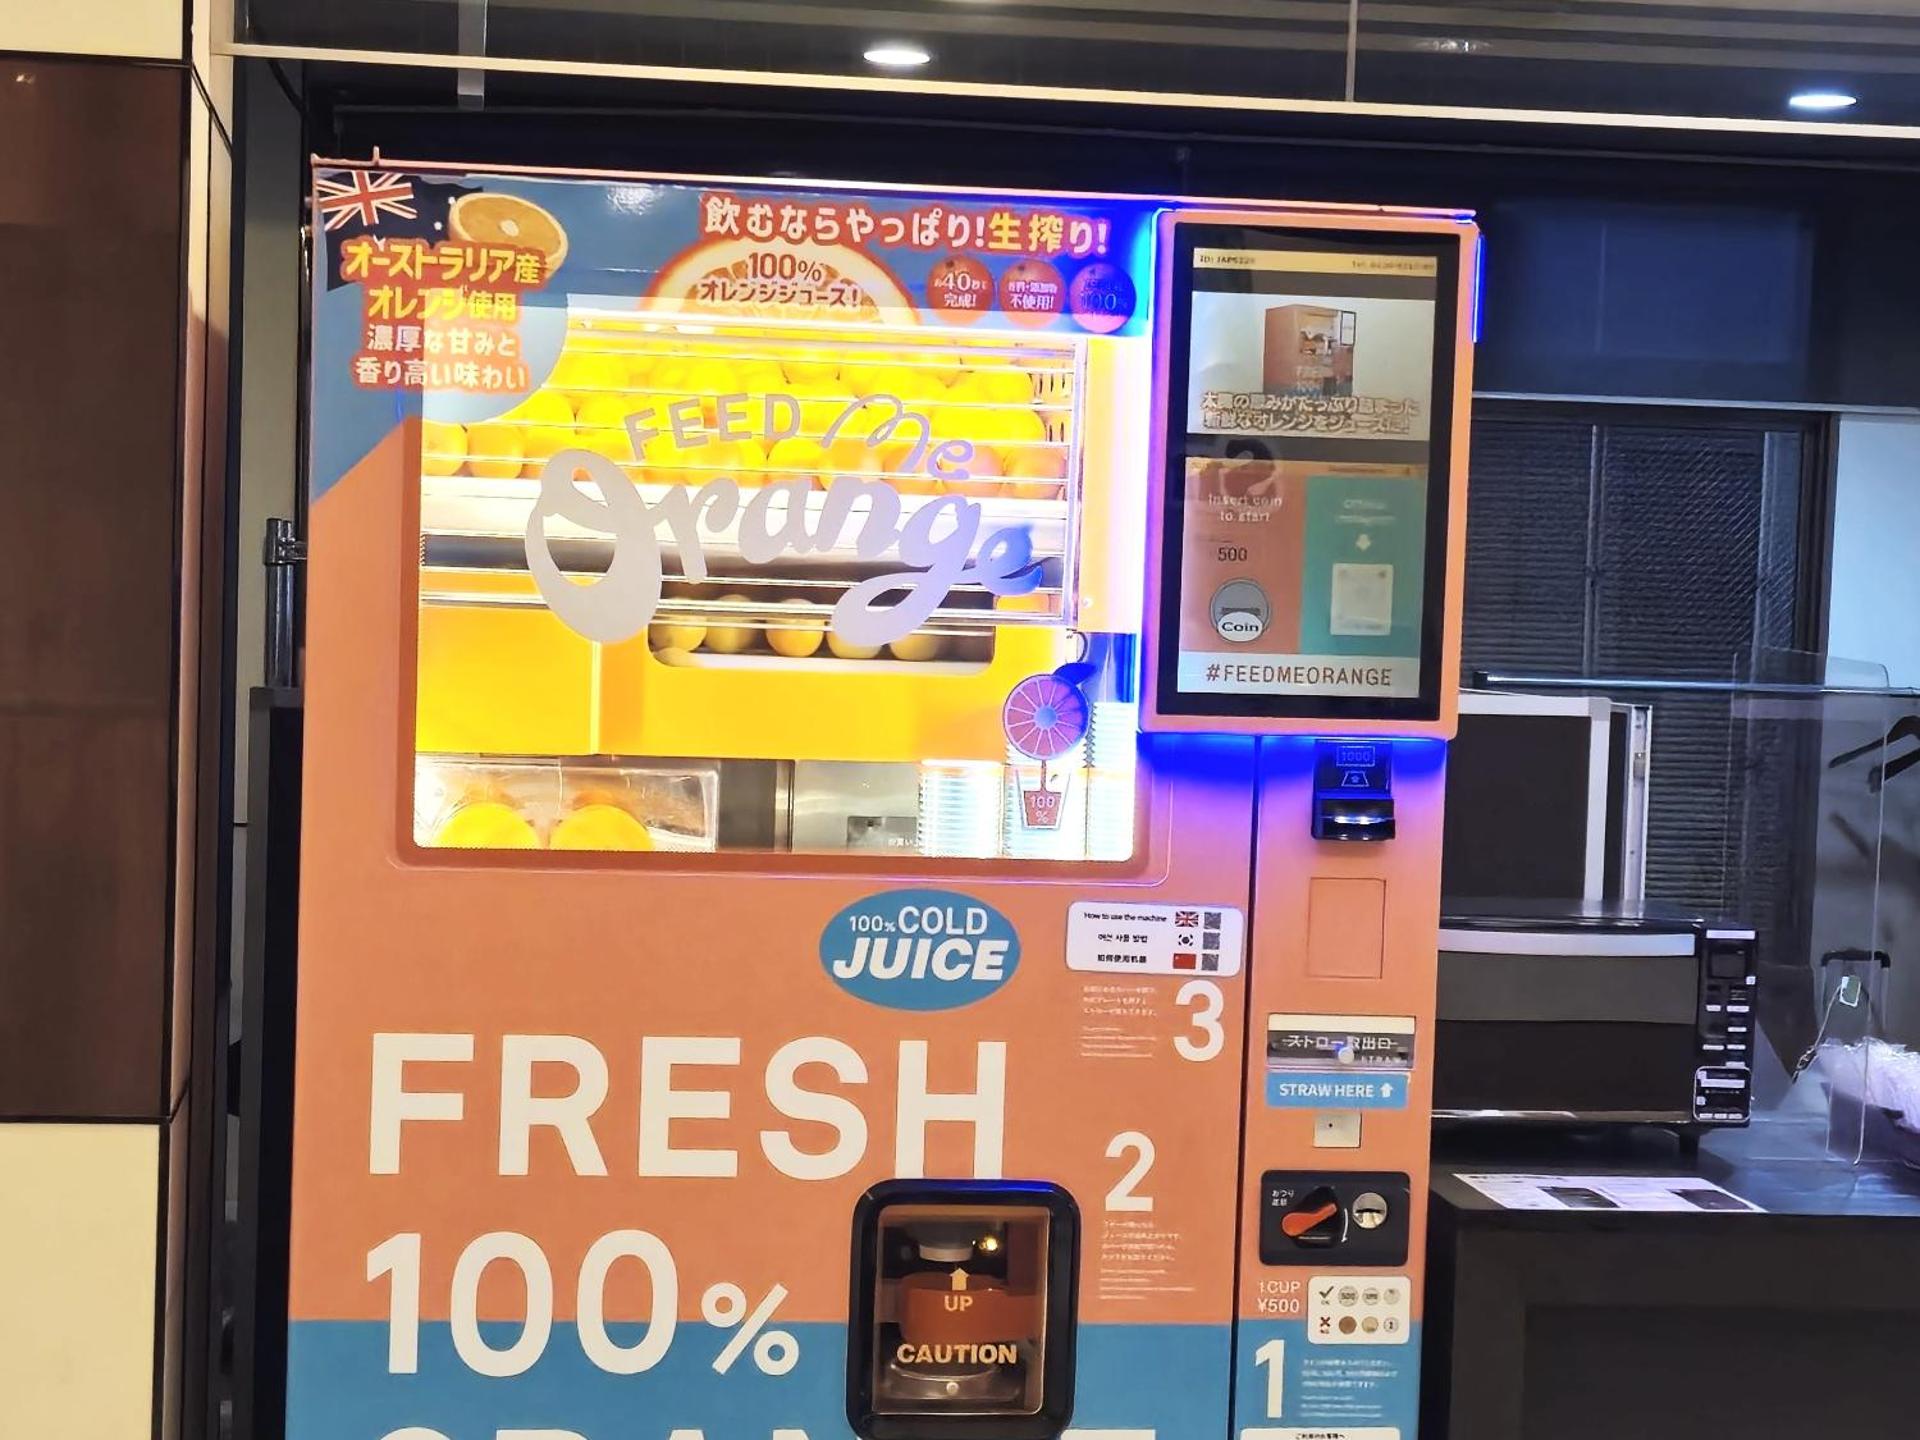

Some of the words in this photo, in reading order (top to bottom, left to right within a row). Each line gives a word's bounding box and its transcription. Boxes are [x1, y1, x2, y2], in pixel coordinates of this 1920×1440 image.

[346, 243, 541, 284] オーストラリア産
[749, 252, 822, 283] 100%
[368, 286, 517, 322] オレンジ使用
[700, 281, 859, 308] オレンジジュース!
[367, 323, 517, 359] 濃厚な甘みと
[355, 355, 525, 390] 香り高い味わい
[624, 393, 800, 462] FEED
[1220, 510, 1234, 522] to
[525, 448, 1044, 644] Orange
[1217, 546, 1248, 562] 500
[1221, 621, 1259, 632] Coin
[1206, 663, 1393, 687] #FEEDMEORANGE
[1030, 795, 1055, 808] 100
[849, 915, 896, 933] 100%
[899, 906, 988, 936] COLD
[1083, 911, 1101, 920] How
[1102, 912, 1110, 920] to
[1111, 913, 1123, 921] use
[1124, 913, 1136, 921] the
[1137, 914, 1167, 923] machine
[832, 937, 1010, 981] JUICE
[1173, 979, 1225, 1062] 3
[1279, 1083, 1331, 1097] STRAW
[1335, 1084, 1375, 1098] HERE
[368, 1032, 1008, 1181] FRESH
[1105, 1131, 1156, 1212] 2
[366, 1229, 800, 1378] 100%
[943, 1295, 973, 1312] UP
[1257, 1298, 1300, 1314] ¥500
[896, 1344, 1018, 1364] CAUTION
[1255, 1339, 1285, 1419] 1
